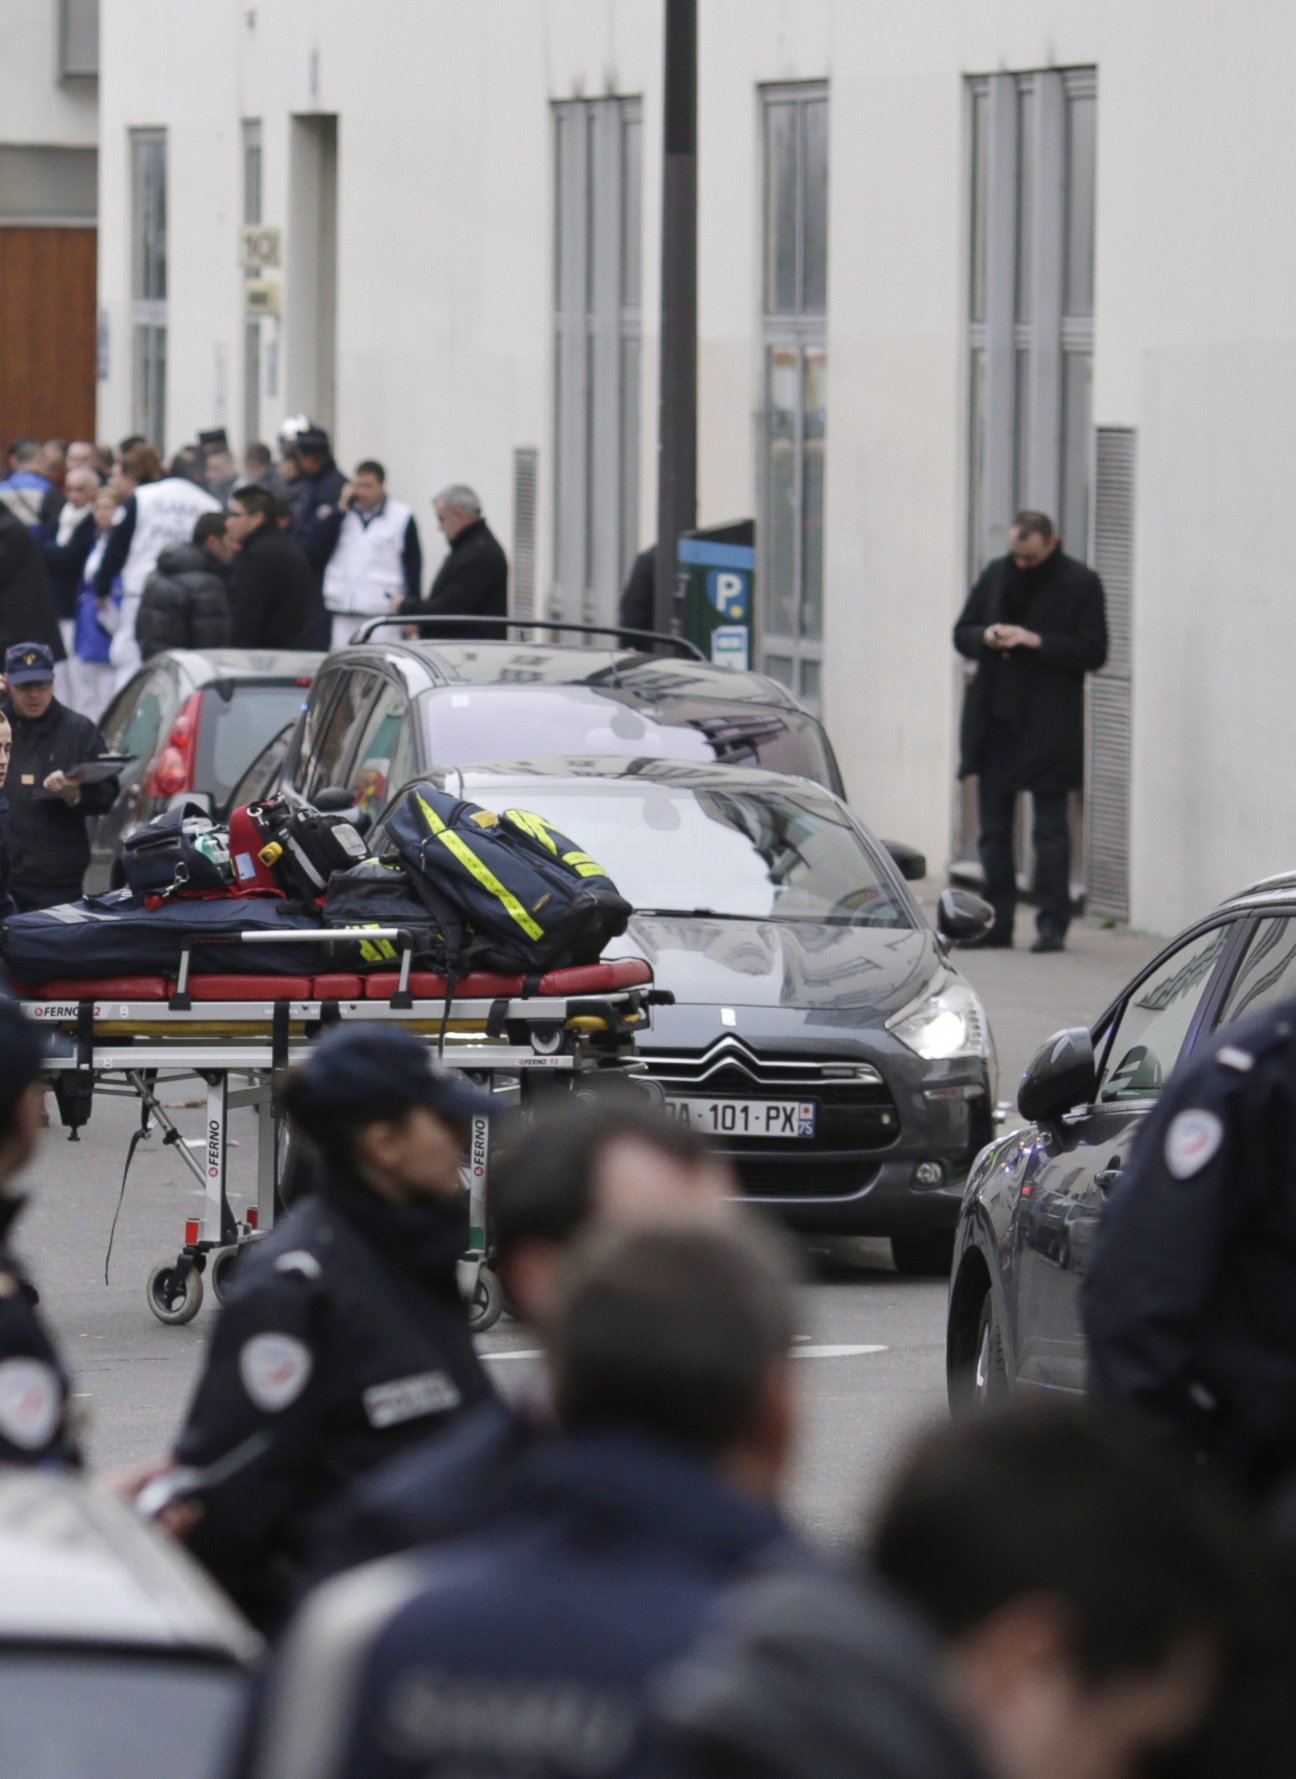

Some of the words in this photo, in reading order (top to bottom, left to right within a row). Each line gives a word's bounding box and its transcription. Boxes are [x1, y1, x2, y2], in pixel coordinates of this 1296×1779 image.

[715, 573, 743, 612] P
[208, 1119, 220, 1166] FERNO
[473, 1119, 486, 1166] FERNO
